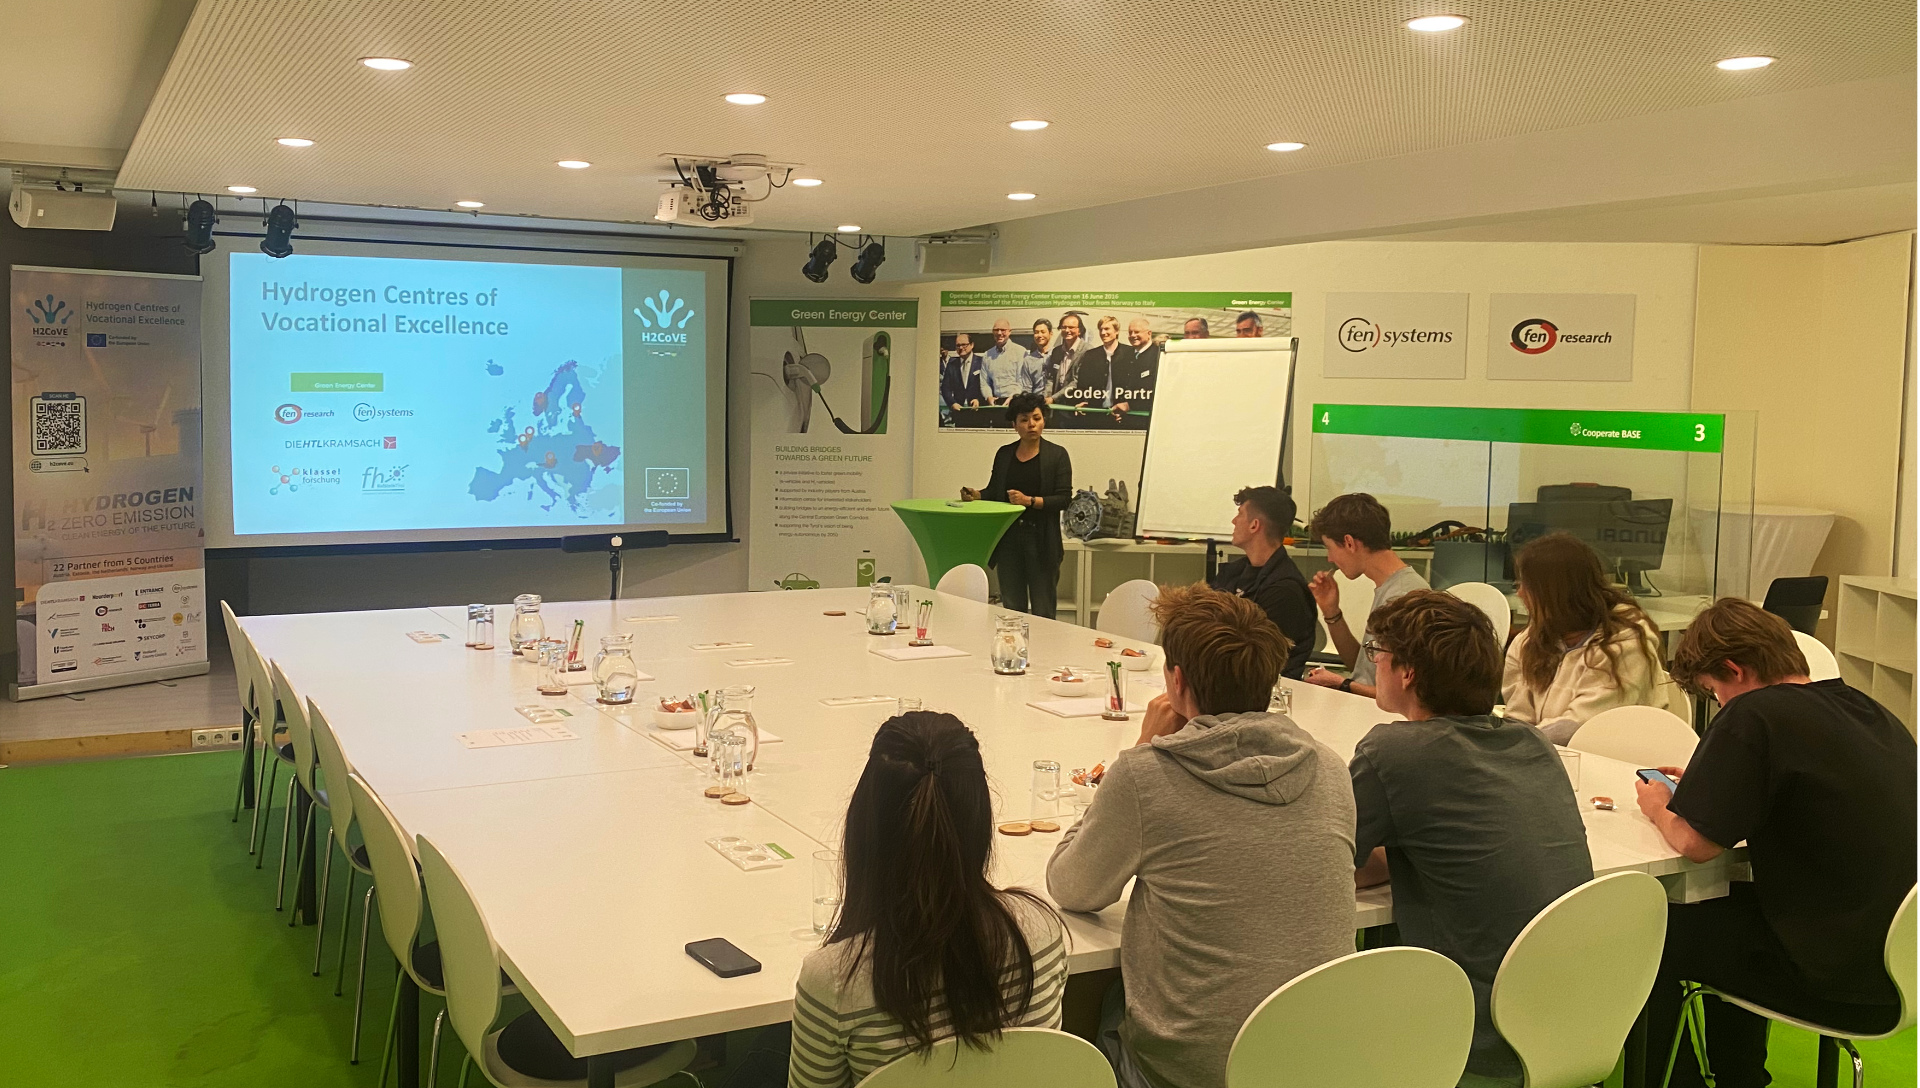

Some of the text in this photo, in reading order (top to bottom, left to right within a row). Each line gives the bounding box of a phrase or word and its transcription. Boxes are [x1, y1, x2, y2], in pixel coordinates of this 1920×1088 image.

[261, 281, 498, 306] Hydrogen Centres of
[86, 301, 181, 312] Hydrogen Centres of
[86, 314, 185, 326] Vocational Excellence
[791, 309, 906, 322] Green Energy Center
[261, 312, 508, 336] Vocational Excellence
[32, 328, 68, 336] H2CoVE
[642, 332, 686, 342] H2CoVE
[1347, 326, 1452, 348] fen systems
[1524, 328, 1612, 344] fen research
[1064, 386, 1110, 399] Codex
[282, 409, 296, 418] fen
[377, 409, 414, 419] systems
[1322, 412, 1330, 425] 4
[1582, 428, 1641, 439] Cooperate BASE
[1694, 424, 1706, 441] 3
[285, 440, 380, 448] DIEHTLKRAMSACH
[303, 477, 340, 485] forschung
[62, 486, 194, 512] HYDROGEN
[62, 505, 194, 530] ZERO EMISSION
[62, 522, 196, 541] CLEAN ENERGY OF THE FUTURE
[54, 564, 64, 572] 22
[68, 561, 100, 570] Partner
[104, 559, 124, 568] from
[134, 555, 174, 564] Countries
